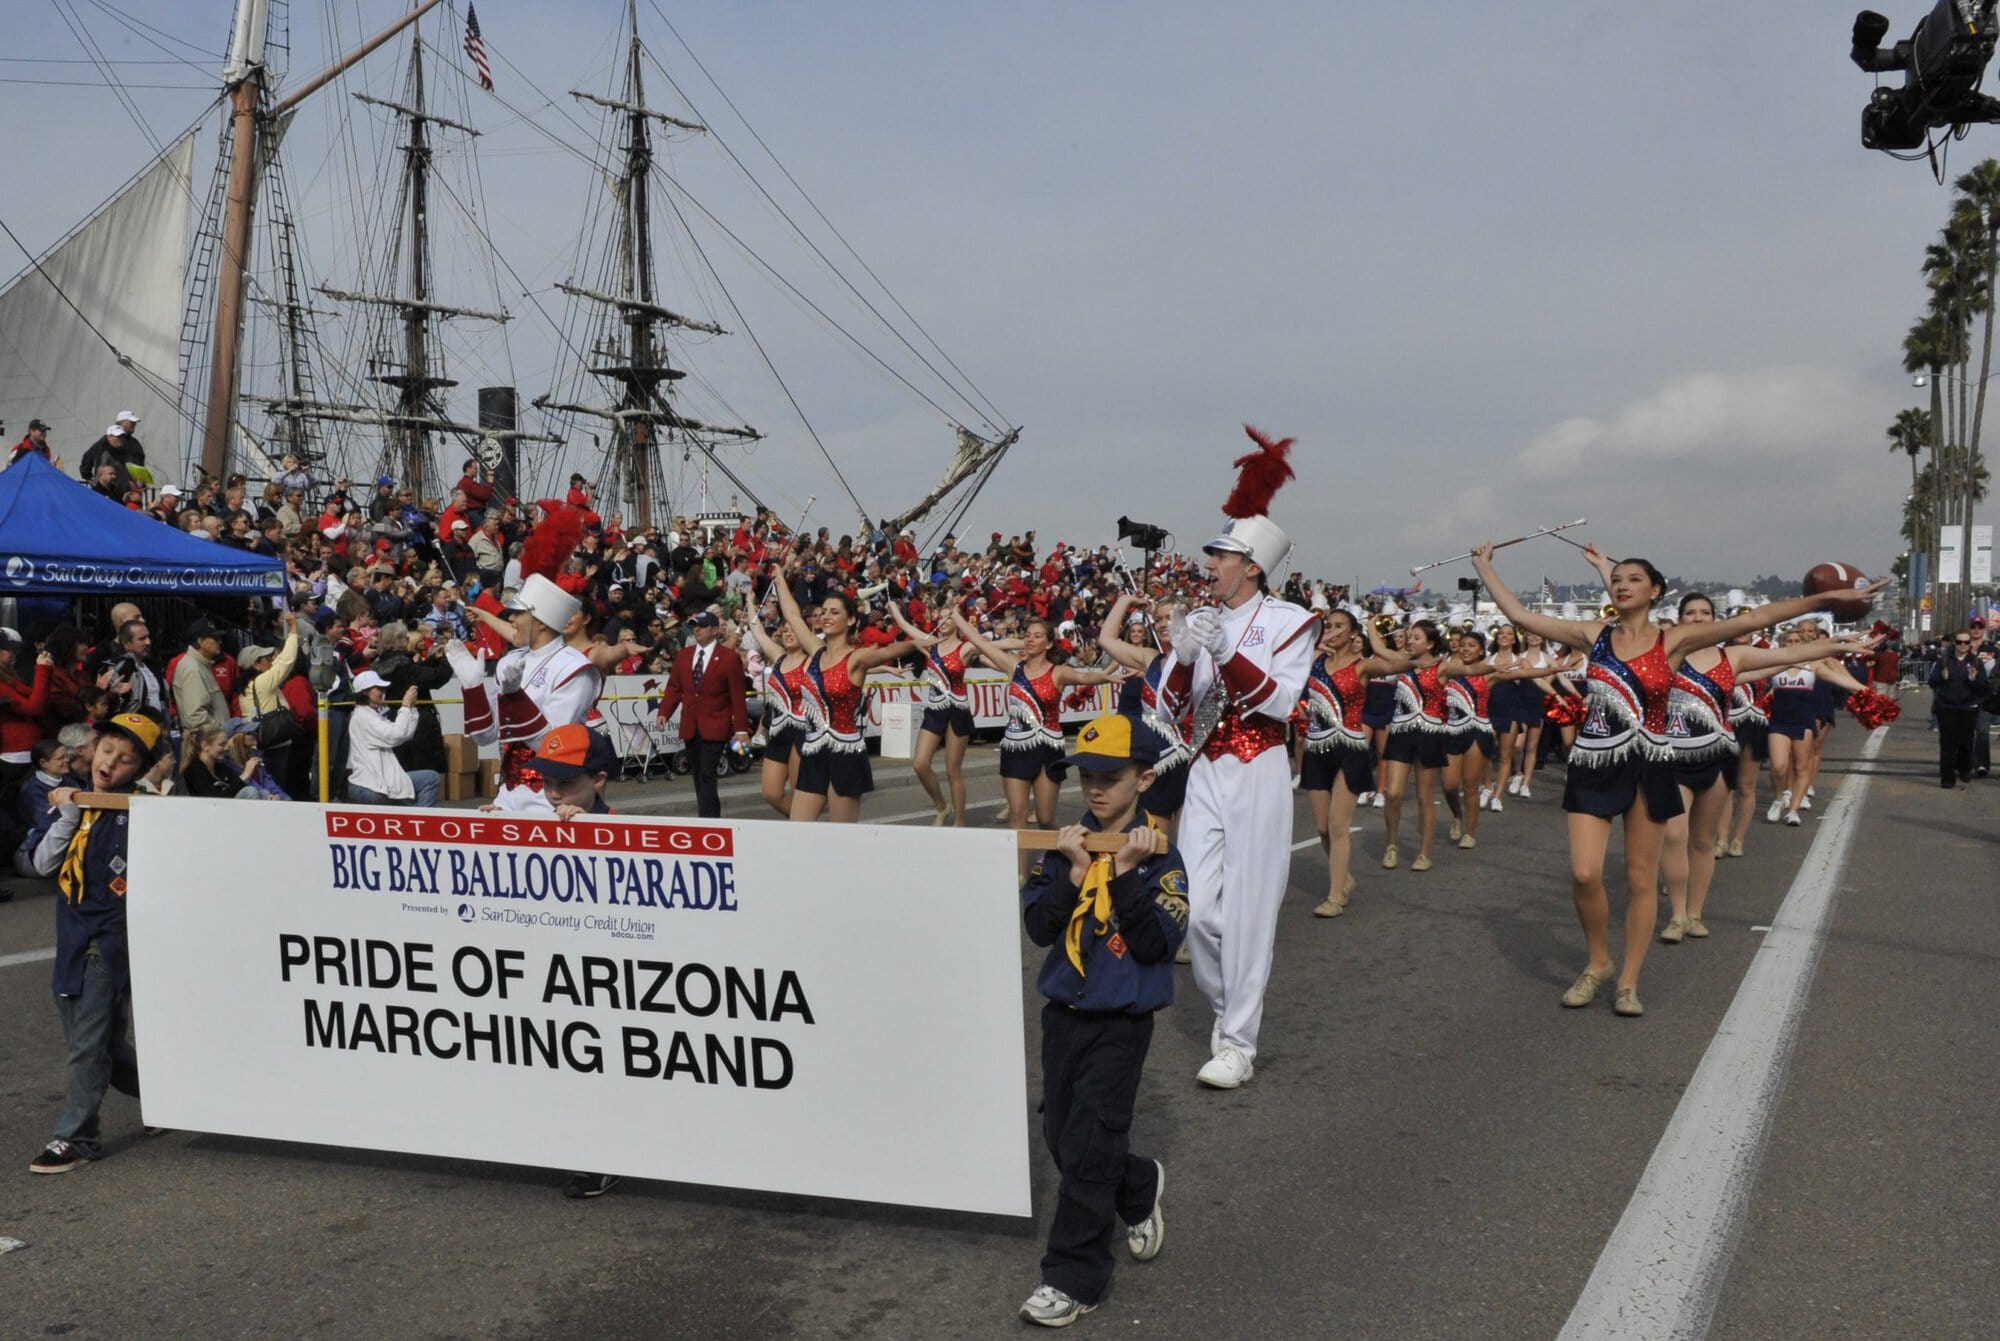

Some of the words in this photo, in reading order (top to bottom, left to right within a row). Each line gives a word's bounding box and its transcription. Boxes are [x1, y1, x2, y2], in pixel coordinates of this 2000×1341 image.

[126, 567, 177, 589] County
[181, 568, 222, 586] Credit
[223, 569, 264, 587] Union
[1243, 626, 1265, 647] A
[1583, 706, 1611, 737] A
[1665, 711, 1691, 737] A
[332, 816, 425, 836] PORT
[440, 821, 486, 839] OF
[502, 824, 576, 844] SAN
[594, 828, 726, 851] DIEGO
[330, 843, 381, 891] BIG
[386, 846, 442, 894] BAY
[448, 849, 599, 905] BALLOON
[605, 856, 738, 912] PARADE
[402, 903, 438, 914] Presented
[440, 904, 449, 916] by
[539, 911, 580, 931] County
[583, 915, 618, 930] Credit
[620, 917, 655, 933] Union
[611, 930, 654, 940] sdccu.com
[279, 933, 438, 993] PRIDE
[452, 946, 525, 999] OF
[542, 953, 816, 1025] ARIZONA
[304, 998, 604, 1074] MARCHING
[621, 1026, 794, 1090] BAND
